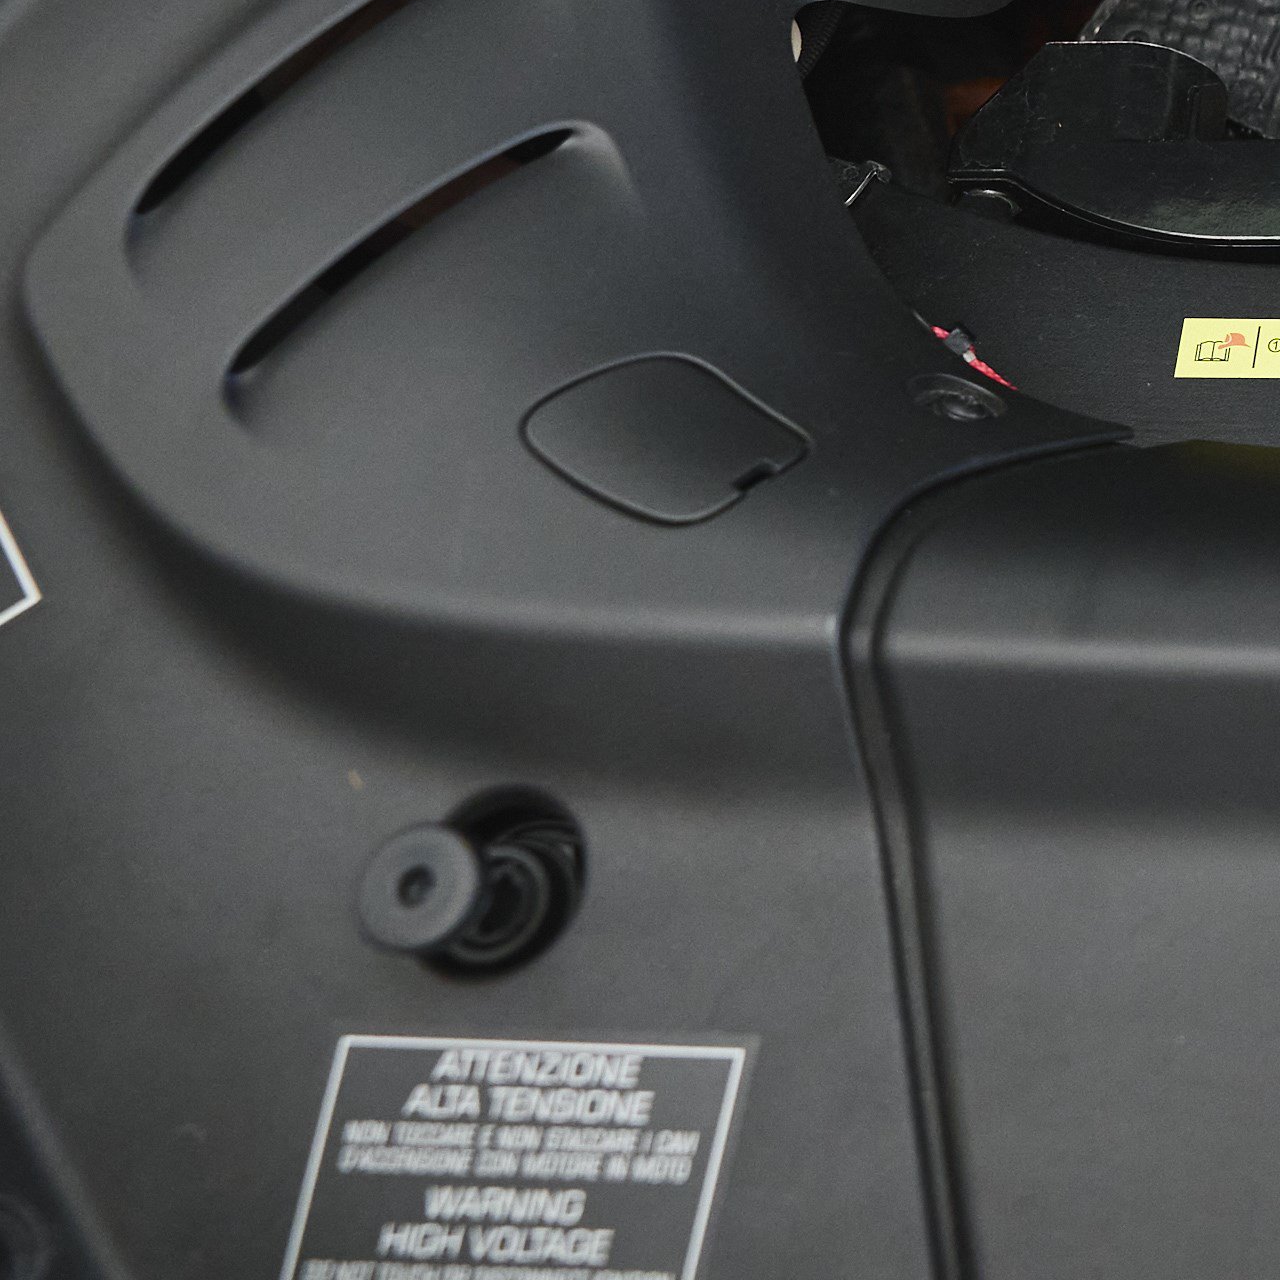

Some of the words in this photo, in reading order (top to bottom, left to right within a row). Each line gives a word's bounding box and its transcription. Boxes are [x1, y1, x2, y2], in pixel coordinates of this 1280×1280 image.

[428, 1049, 643, 1089] ATTENZIONE
[401, 1082, 481, 1121] ALTA
[486, 1085, 656, 1126] TENSIONE
[424, 1184, 587, 1227] WARNING
[374, 1221, 467, 1261] HIGH
[466, 1223, 616, 1267] VOLTAGE
